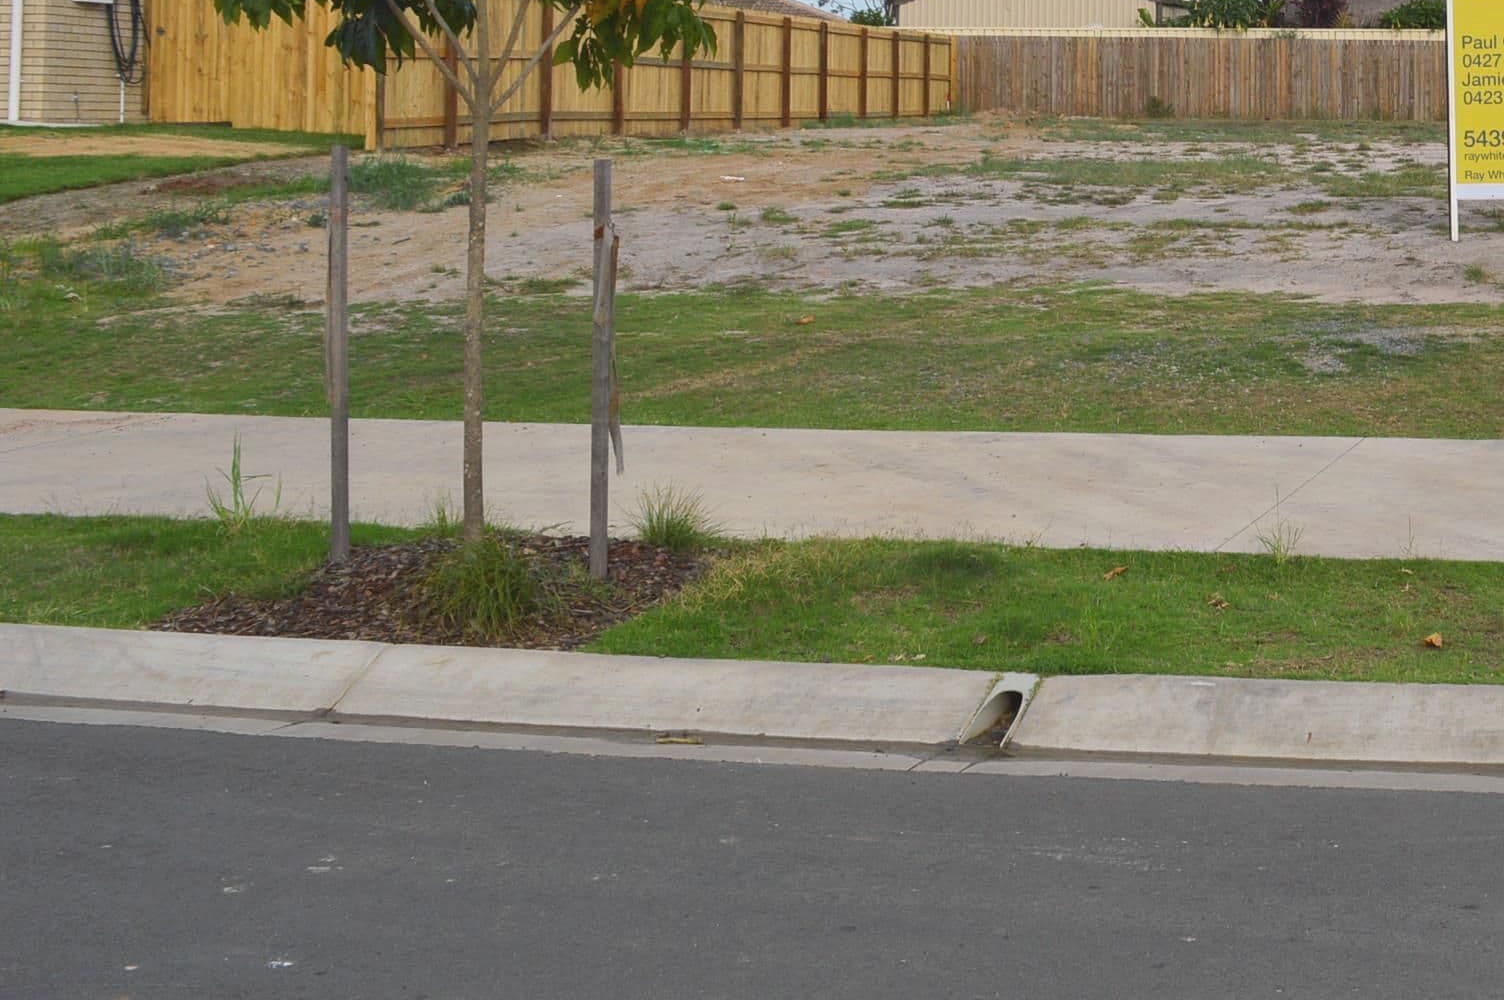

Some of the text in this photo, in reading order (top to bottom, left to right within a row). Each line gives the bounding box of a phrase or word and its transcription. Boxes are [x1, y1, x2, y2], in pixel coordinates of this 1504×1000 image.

[1461, 34, 1497, 49] Paul
[1462, 53, 1502, 68] 0427
[1463, 91, 1503, 105] 0423
[1464, 170, 1485, 181] Ray
